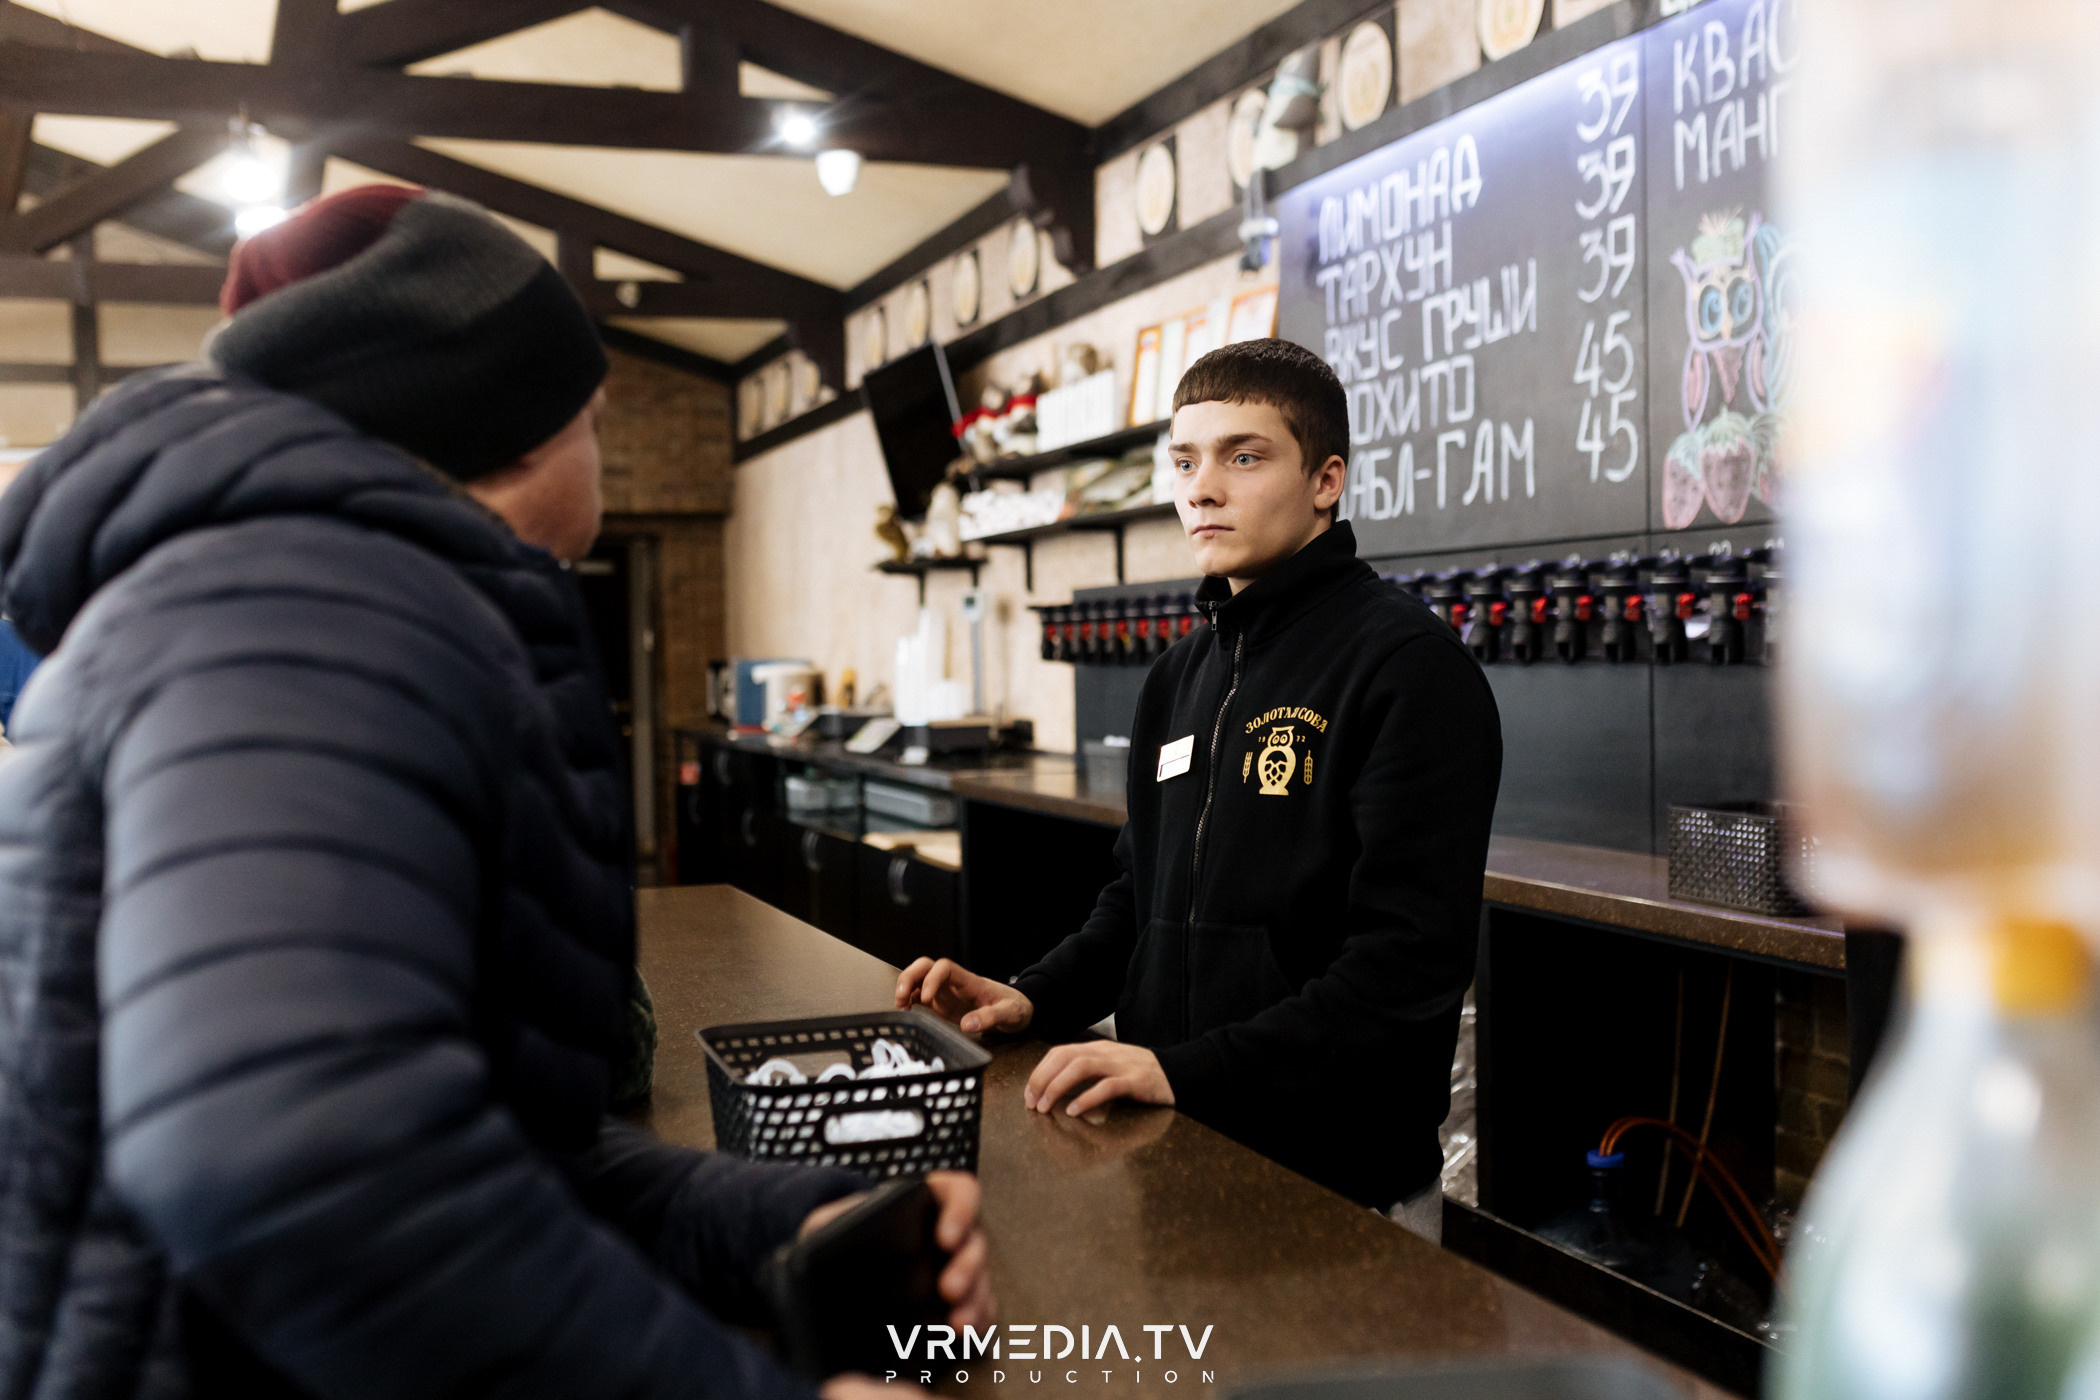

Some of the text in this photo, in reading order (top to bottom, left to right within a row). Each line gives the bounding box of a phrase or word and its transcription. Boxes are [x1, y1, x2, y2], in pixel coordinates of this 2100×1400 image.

[1318, 51, 1638, 264] ЛИМОНАД 39
[1673, 78, 1792, 191] МАНГ
[1316, 134, 1636, 326] ТАРХУН 39
[1324, 308, 1403, 384] ВКУС
[1422, 258, 1537, 362] ГРУШИ
[1577, 213, 1636, 303] 39
[1346, 354, 1475, 446] ОХИТО
[1573, 310, 1634, 398] 45
[1576, 388, 1639, 482] 45
